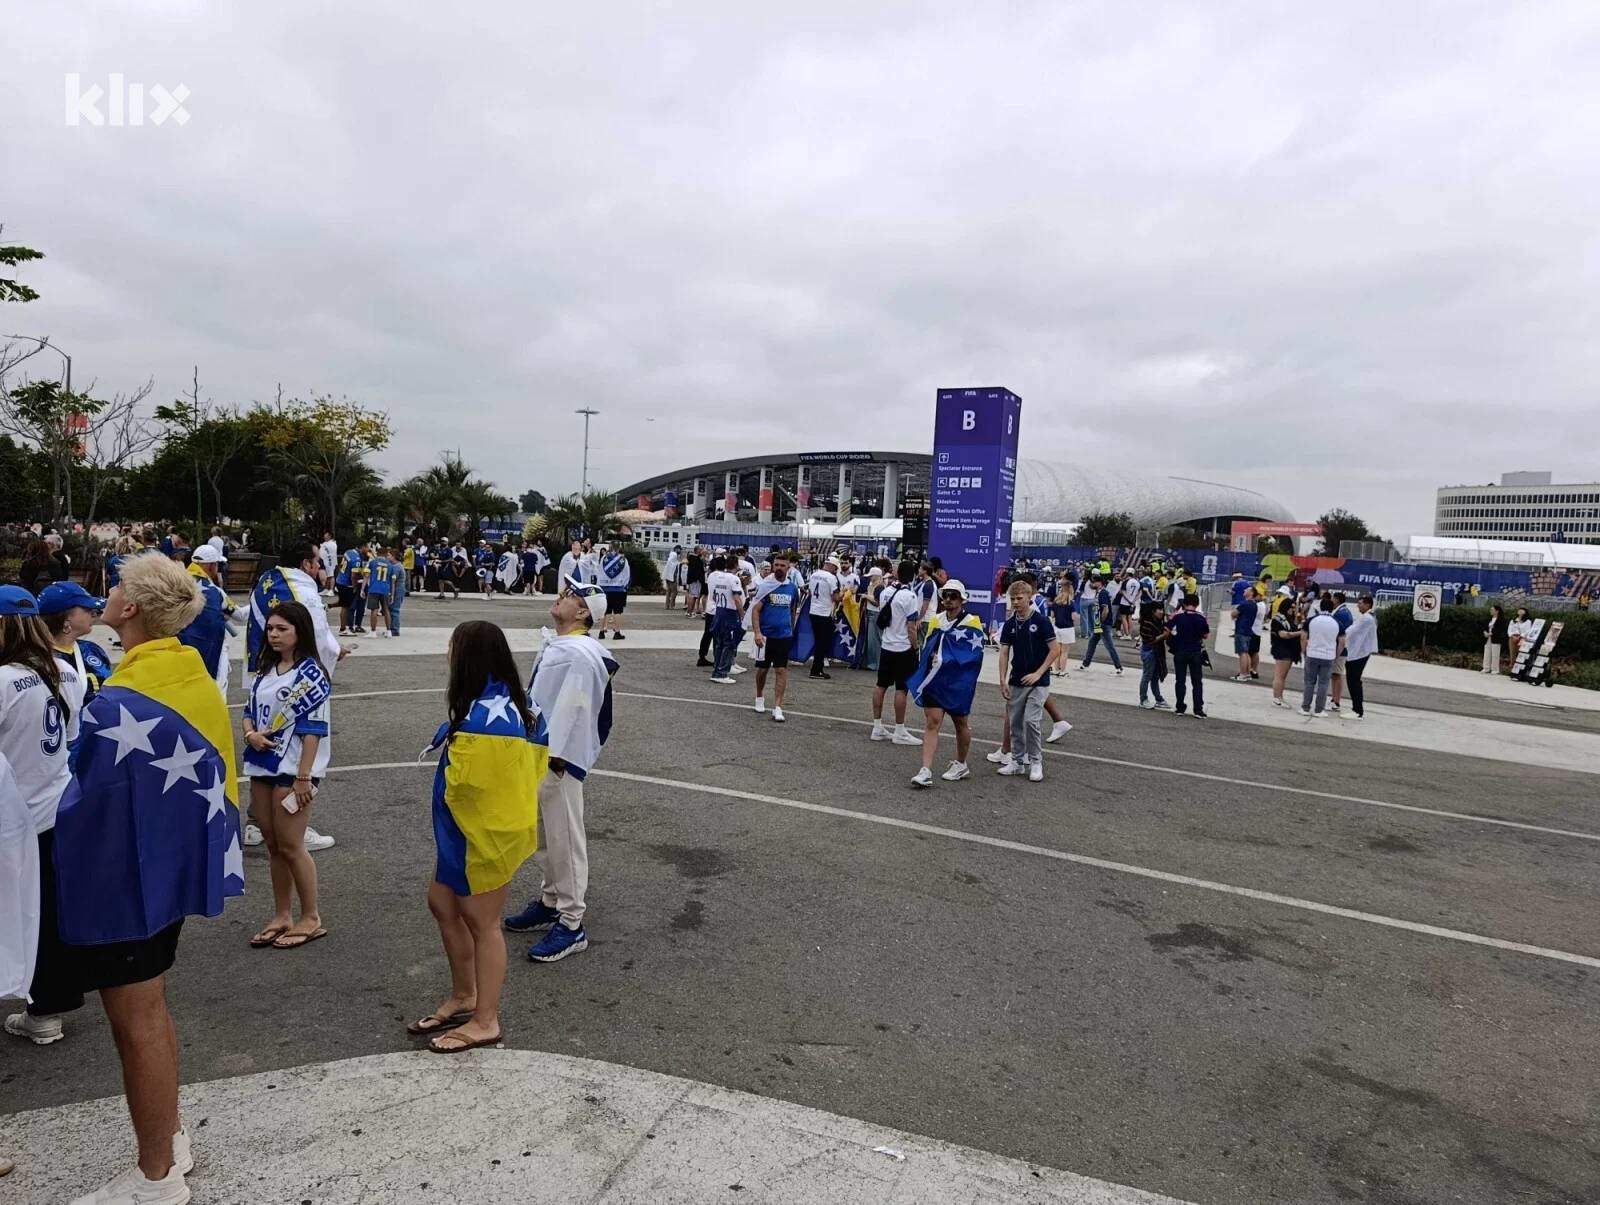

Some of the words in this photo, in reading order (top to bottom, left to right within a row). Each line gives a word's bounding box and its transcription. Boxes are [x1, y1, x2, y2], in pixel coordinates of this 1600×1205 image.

[962, 409, 976, 431] B
[376, 566, 388, 582] 11
[1360, 574, 1381, 584] FIFA
[1382, 576, 1419, 587] WORLD
[813, 582, 819, 599] 4
[13, 674, 41, 692] BOSNA
[258, 703, 271, 726] 19
[41, 695, 62, 756] 9
